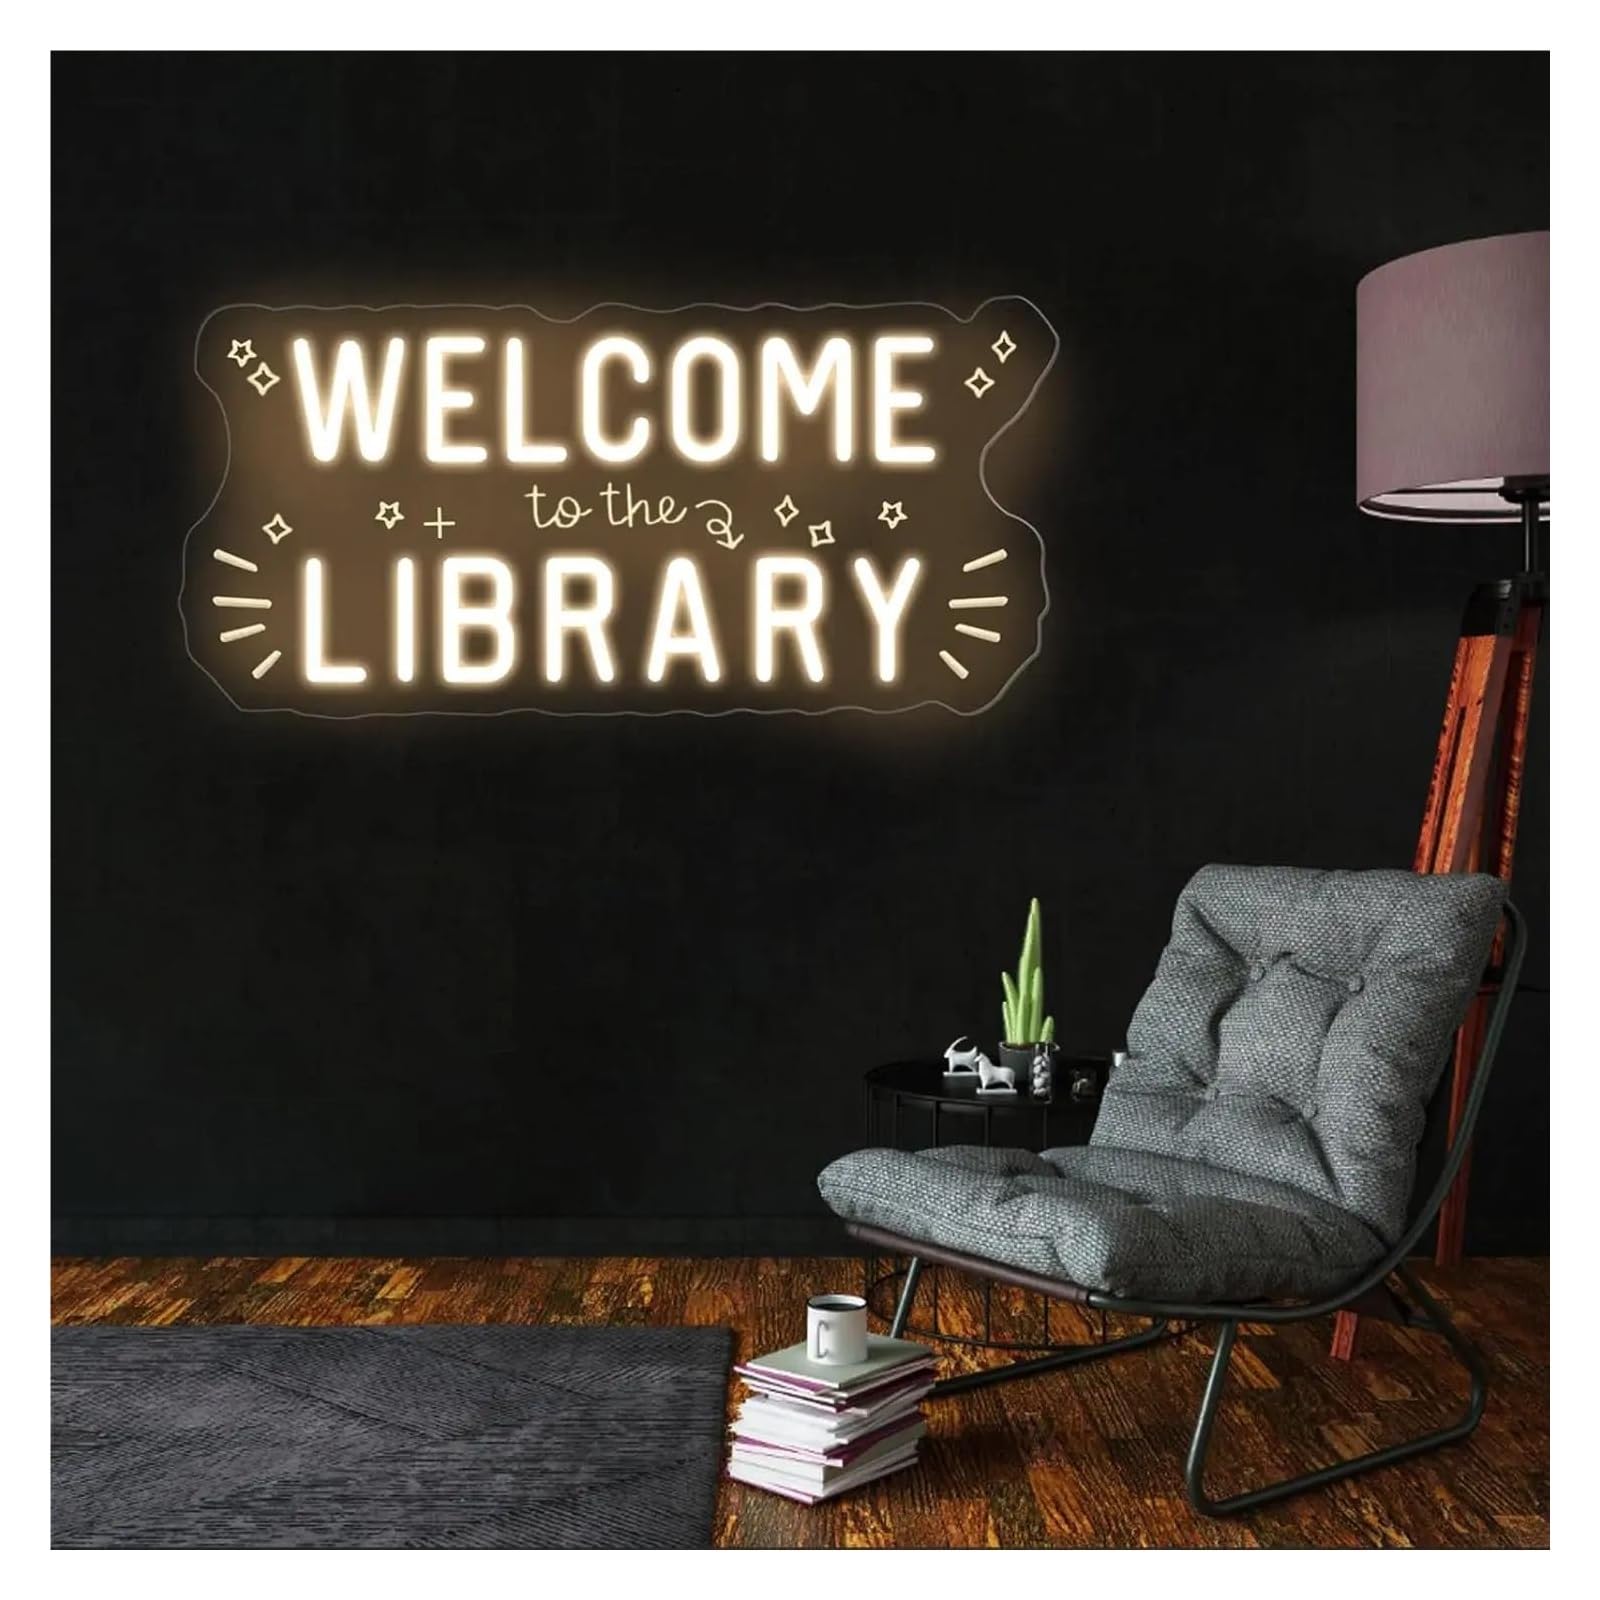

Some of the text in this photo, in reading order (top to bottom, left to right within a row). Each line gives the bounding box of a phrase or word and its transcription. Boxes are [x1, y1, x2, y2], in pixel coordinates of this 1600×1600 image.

[292, 335, 936, 465] WELCOME
[524, 482, 687, 528] to the
[303, 556, 921, 684] LIBRARY
